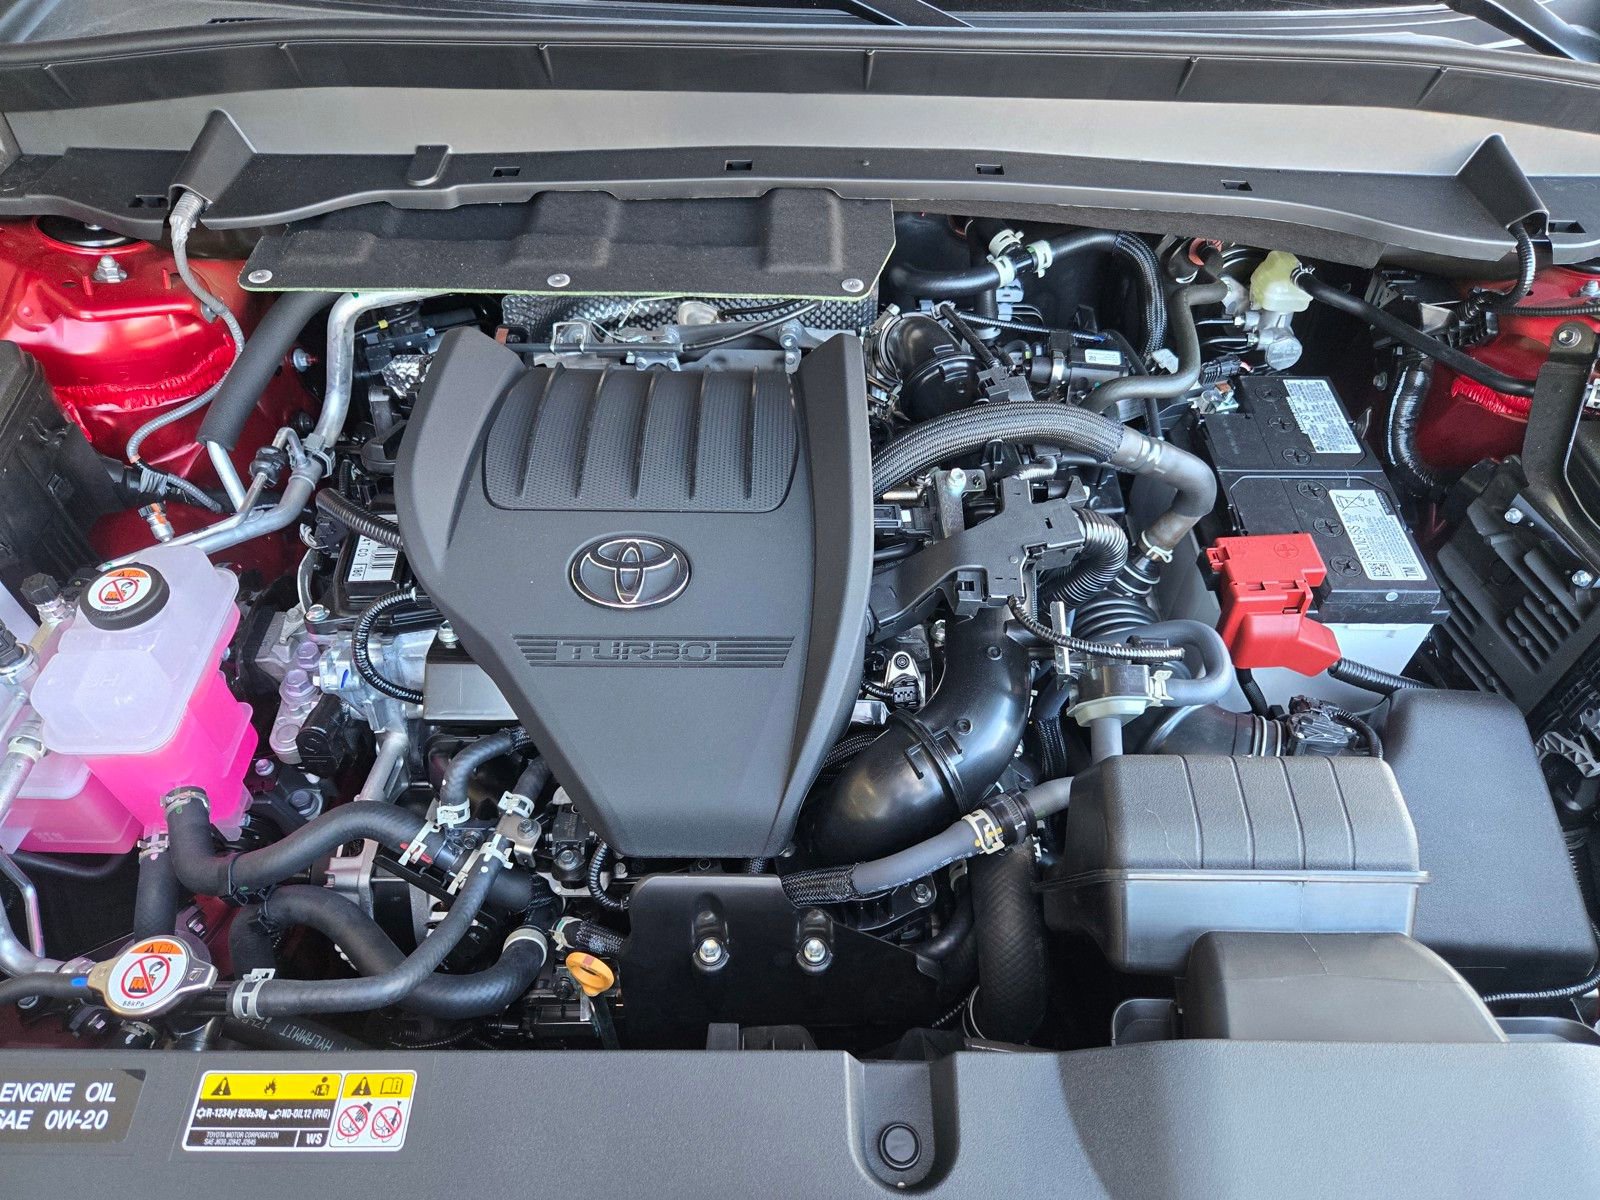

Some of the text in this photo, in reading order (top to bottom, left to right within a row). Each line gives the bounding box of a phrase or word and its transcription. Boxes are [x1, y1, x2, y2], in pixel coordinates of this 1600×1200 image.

[561, 641, 711, 661] TURBO
[0, 1082, 116, 1102] ENGINE OIL
[44, 1109, 108, 1130] 0W-20
[306, 1132, 323, 1145] WS
